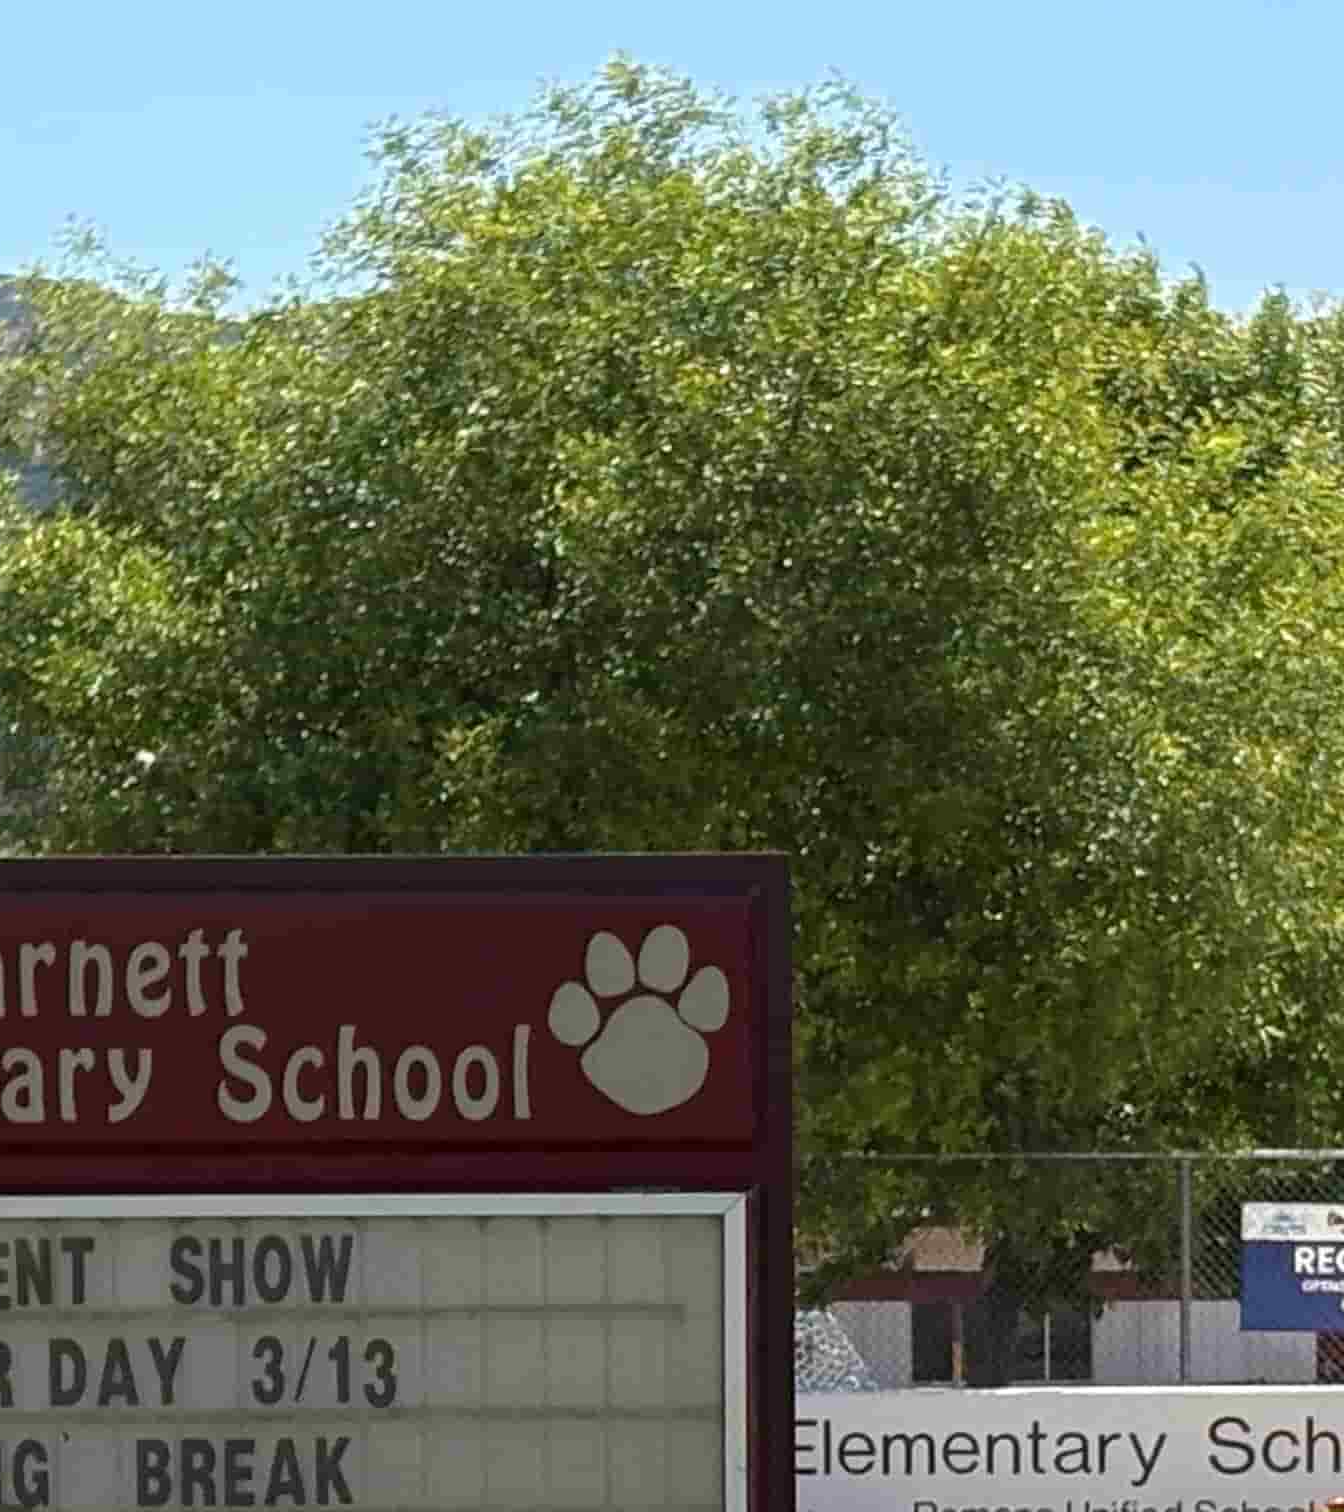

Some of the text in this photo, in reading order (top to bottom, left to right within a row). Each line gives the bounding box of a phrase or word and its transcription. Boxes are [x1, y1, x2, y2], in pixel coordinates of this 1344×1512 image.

[215, 1023, 534, 1122] School
[169, 1234, 354, 1307] SHOW
[250, 1335, 398, 1409] 3/13
[136, 1436, 355, 1508] BREAK
[794, 1418, 1168, 1487] Elementary
